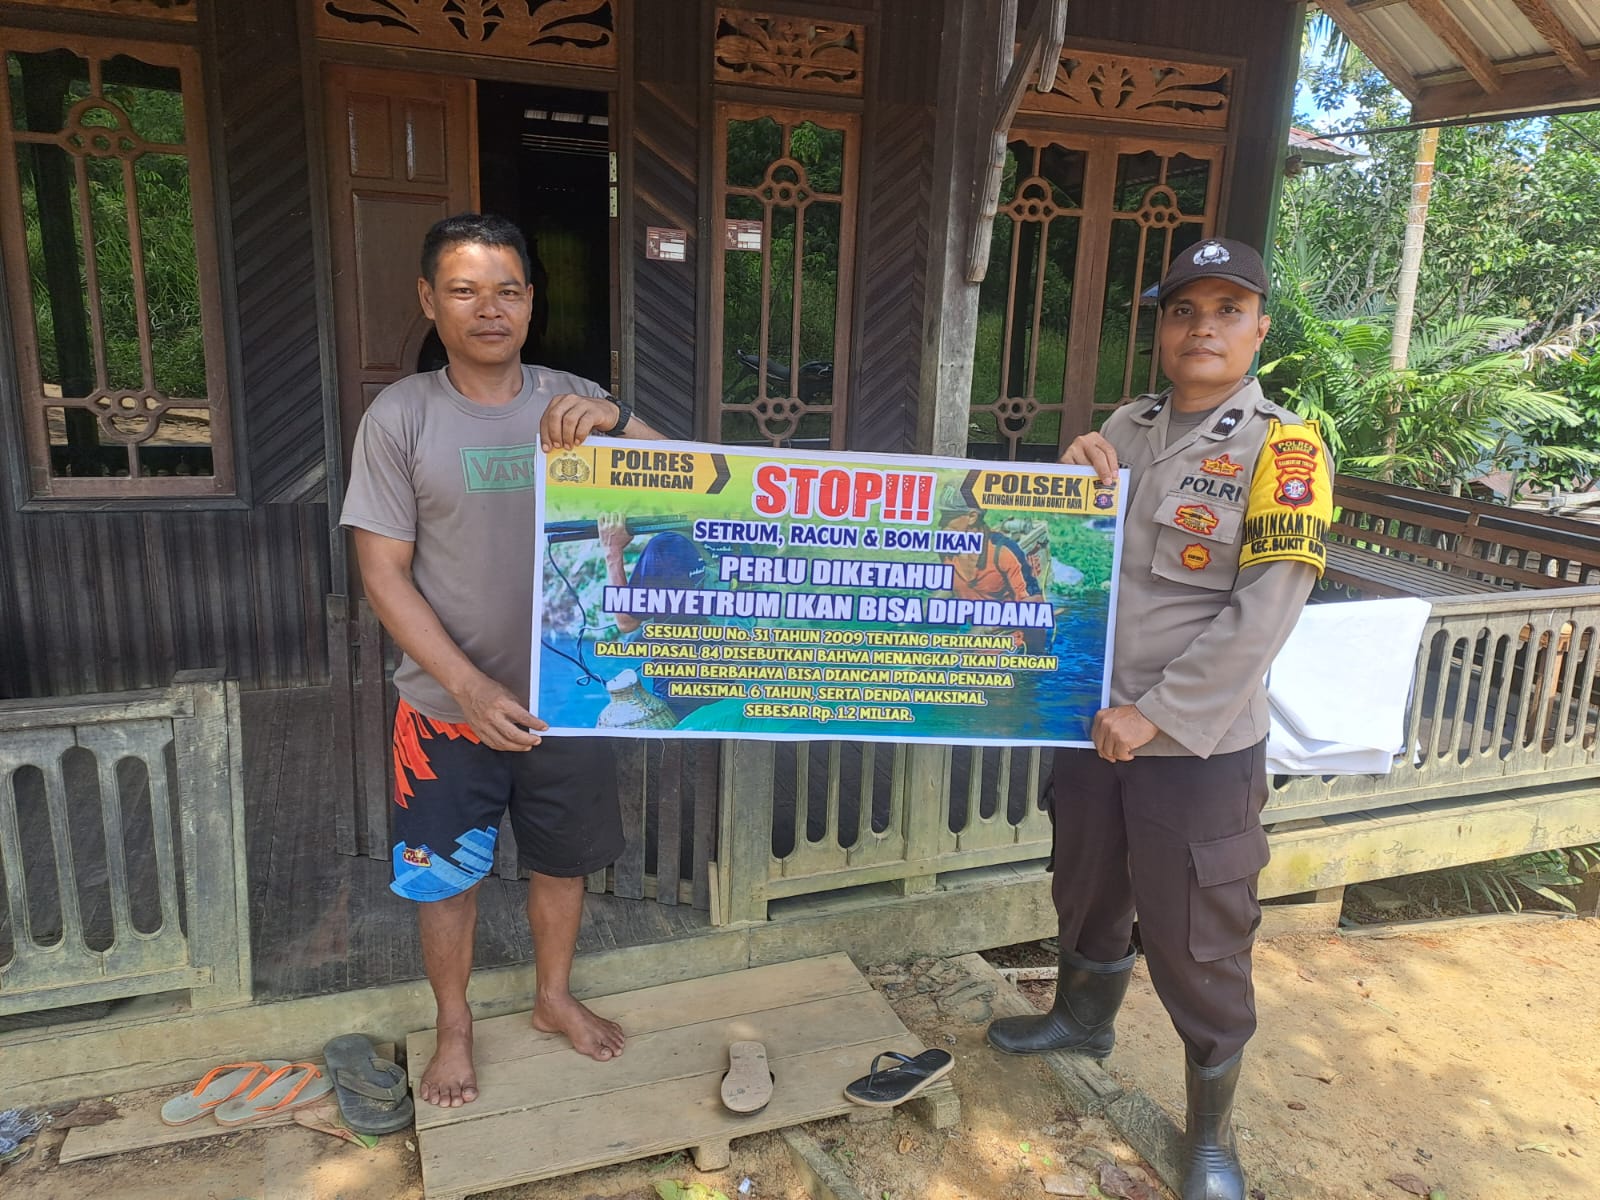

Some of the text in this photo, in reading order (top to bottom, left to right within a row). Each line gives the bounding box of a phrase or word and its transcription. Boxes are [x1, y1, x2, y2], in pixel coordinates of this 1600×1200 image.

[611, 448, 694, 473] POLRES
[610, 471, 694, 490] KATINGAN
[984, 473, 1083, 497] POLSEK
[1179, 476, 1243, 502] POLRI
[755, 465, 934, 522] STOP!!!
[982, 493, 1082, 510] KATINGAN HULU DAN BUKIT RAYA
[695, 521, 982, 551] SETRUM, RACUN & BOM IKAN
[721, 556, 806, 584] PERLU
[812, 559, 953, 590] DIKETAHUI
[604, 587, 1054, 628] MENYETRUM IKAN BISA DIPIDANA
[645, 625, 1016, 651] SESUAI UU No. 31 TAHUN 2009 TENTANG PERIKANAN,
[596, 642, 1057, 670] DALAM PASAL 84 DISEBUTKAN BAHWA MENANGKAP IKAN DENGAN
[644, 663, 1013, 688] BAHAN BERBAHAYA BISA DIANCAM PIDANA PENJARA
[671, 683, 987, 706] MAKSIMAL 6 TAHUN, SERTA DENDA MAKSIMAL
[745, 703, 809, 719] SEBESAR
[811, 706, 834, 722] Rp.
[859, 708, 914, 722] MILIAR.
